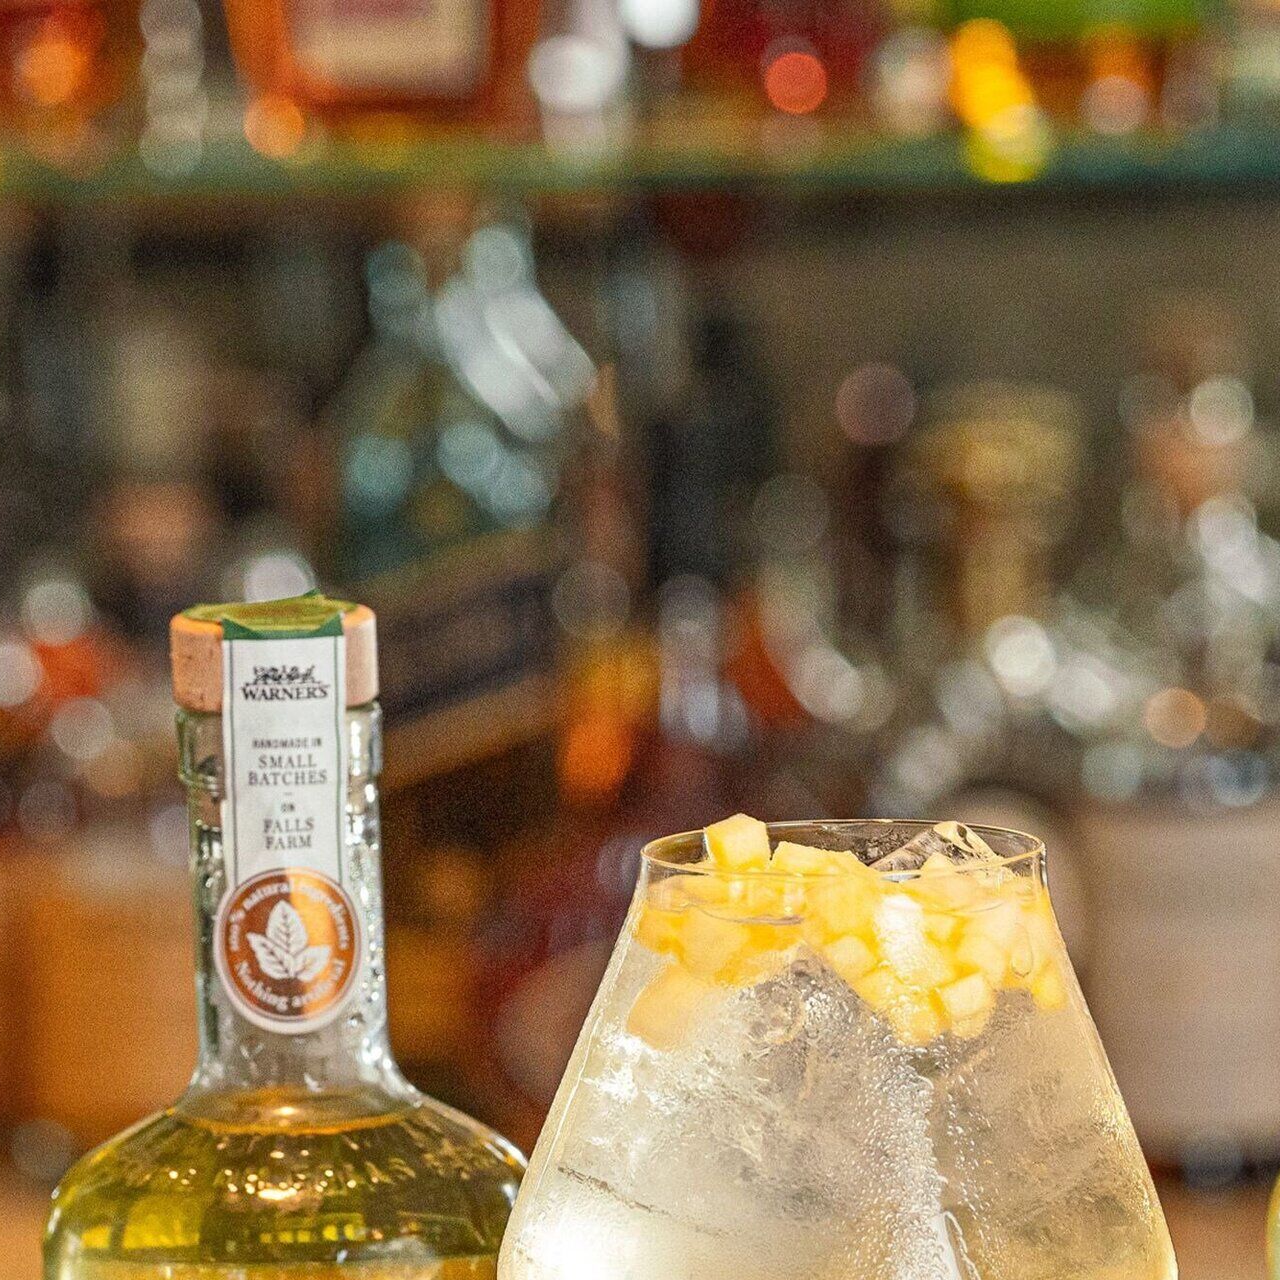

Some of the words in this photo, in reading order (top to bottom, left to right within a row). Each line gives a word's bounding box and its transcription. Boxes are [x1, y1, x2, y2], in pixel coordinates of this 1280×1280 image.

[252, 737, 307, 749] HANDMADE
[311, 737, 322, 747] IN
[258, 754, 318, 769] SMALL
[247, 770, 328, 786] BATCHES
[263, 817, 315, 834] FALLS
[265, 835, 312, 850] FARM
